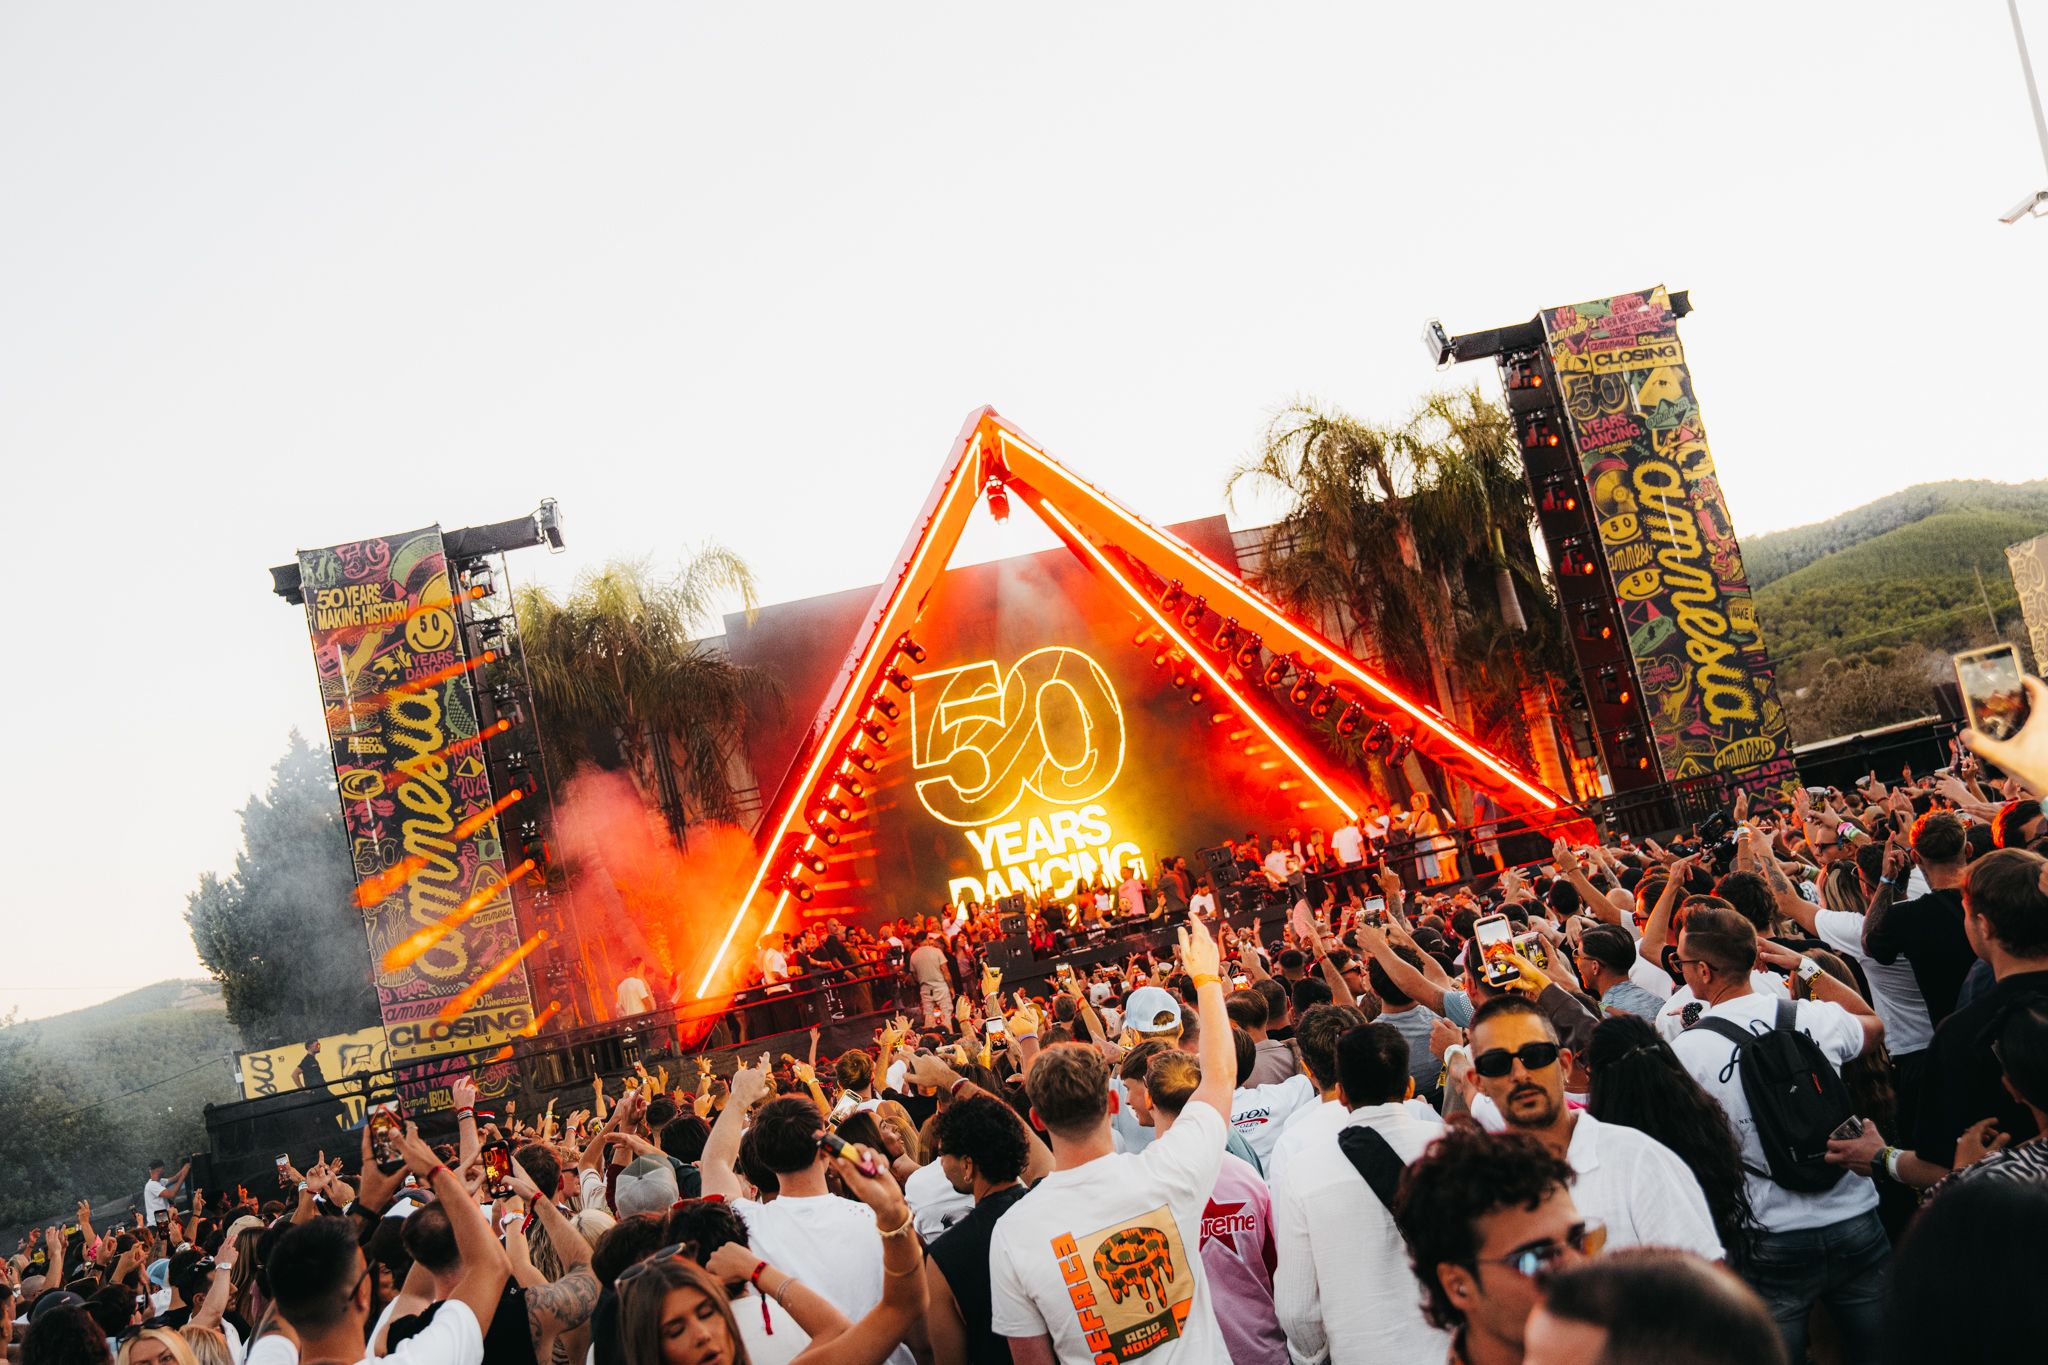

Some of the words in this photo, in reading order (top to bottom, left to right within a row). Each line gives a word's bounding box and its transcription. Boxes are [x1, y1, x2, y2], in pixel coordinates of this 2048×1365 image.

[1594, 345, 1677, 367] CLOSING
[1562, 373, 1630, 420] 50
[1583, 412, 1628, 435] YEARS
[1580, 423, 1641, 450] DANCING
[1609, 516, 1632, 533] 50
[336, 538, 390, 579] 50
[1631, 571, 1654, 588] 50
[317, 588, 345, 611] 50
[345, 582, 382, 607] YEARS
[1632, 458, 1759, 726] amnesia
[317, 605, 360, 631] MAKING
[362, 600, 409, 626] HISTORY
[419, 613, 440, 633] 50
[1730, 606, 1750, 620] WAKE
[411, 650, 456, 667] YEARS
[348, 736, 382, 745] ENJOY
[348, 743, 388, 754] FREEDOM
[910, 646, 1126, 827] 50
[449, 737, 482, 766] 1976
[458, 775, 489, 799] 2026
[964, 804, 1113, 871] YEARS
[948, 841, 1149, 920] DANCING
[394, 979, 428, 997] YEARS
[485, 995, 530, 1008] ANNIVERSARY
[389, 1008, 530, 1048] CLOSING
[393, 1032, 513, 1057] FESTIVA
[485, 1064, 518, 1082] DANCI
[429, 1089, 454, 1107] IBIZA
[1050, 1231, 1121, 1365] DEFACE
[1121, 1326, 1170, 1357] HOUSE
[1125, 1321, 1161, 1344] ACID
